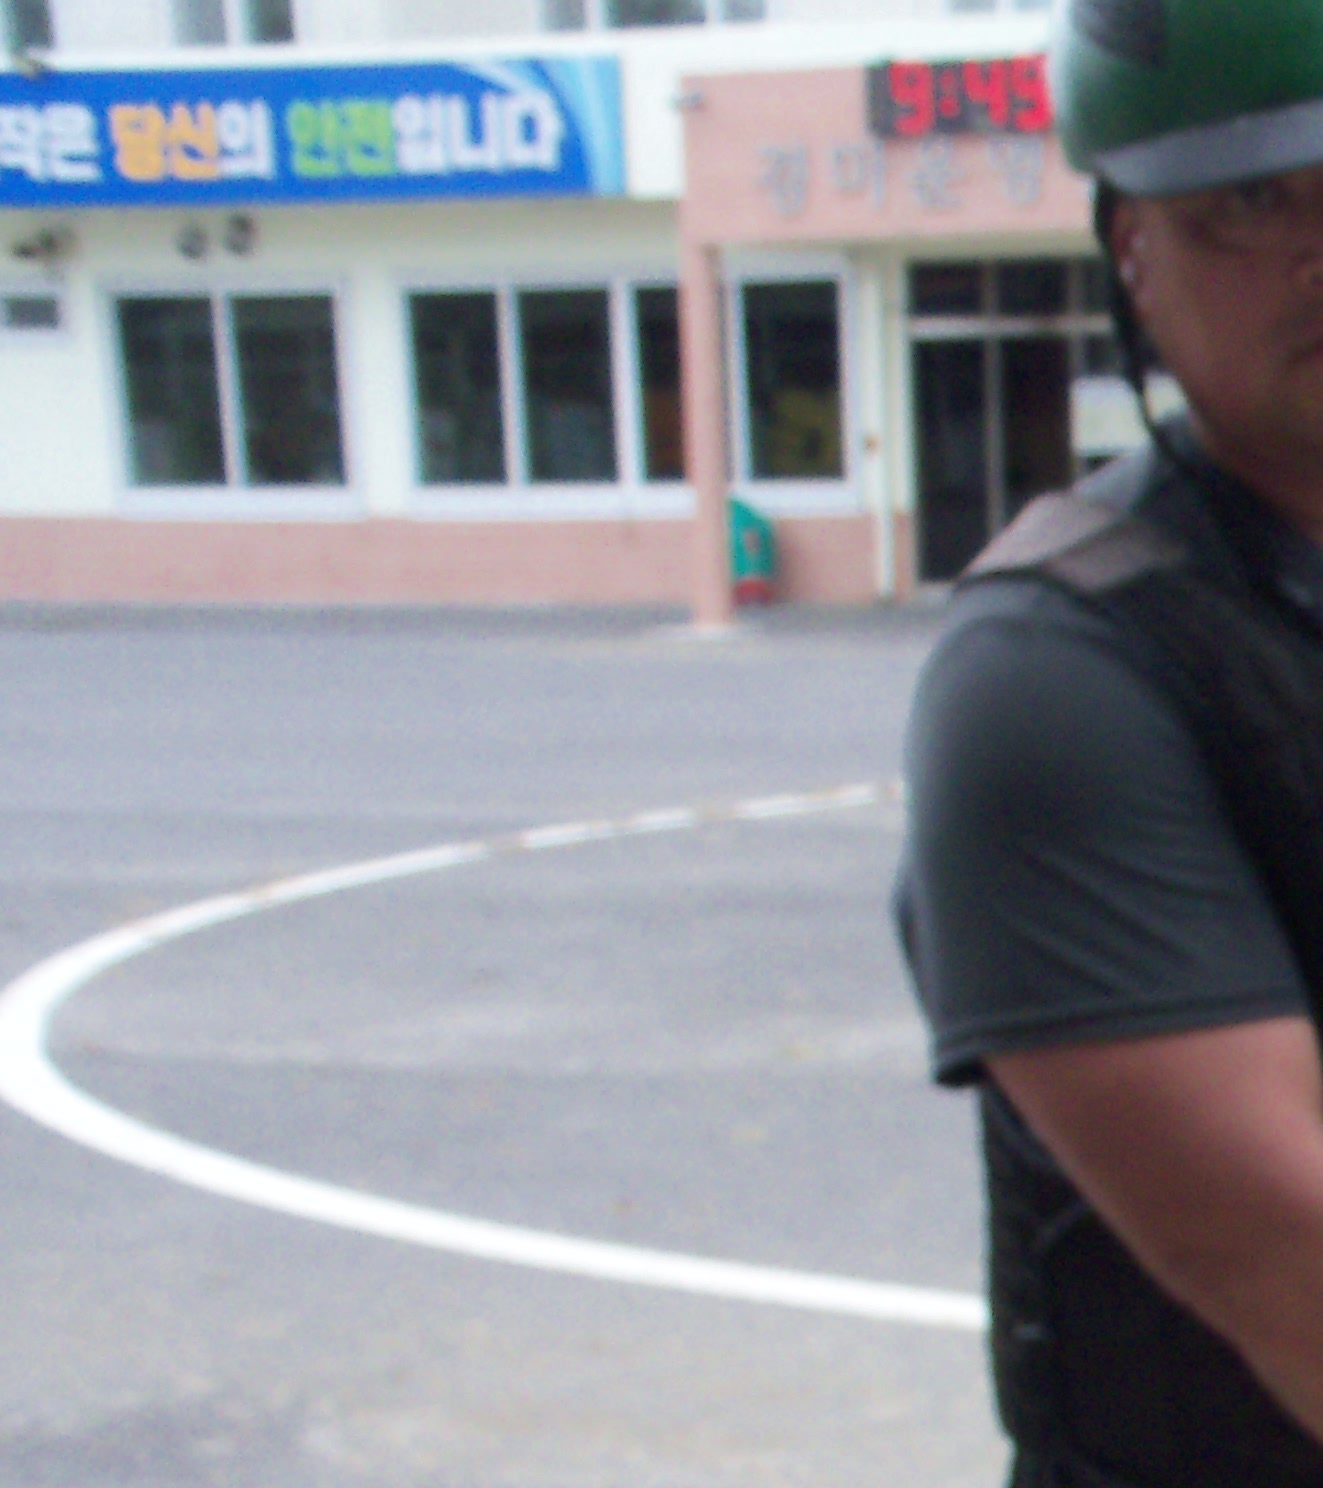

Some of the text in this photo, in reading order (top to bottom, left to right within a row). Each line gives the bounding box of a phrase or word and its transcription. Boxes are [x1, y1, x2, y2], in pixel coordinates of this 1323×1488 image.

[109, 98, 274, 180] 당신의
[288, 92, 560, 176] 안전입니다
[888, 53, 1053, 137] 9:49
